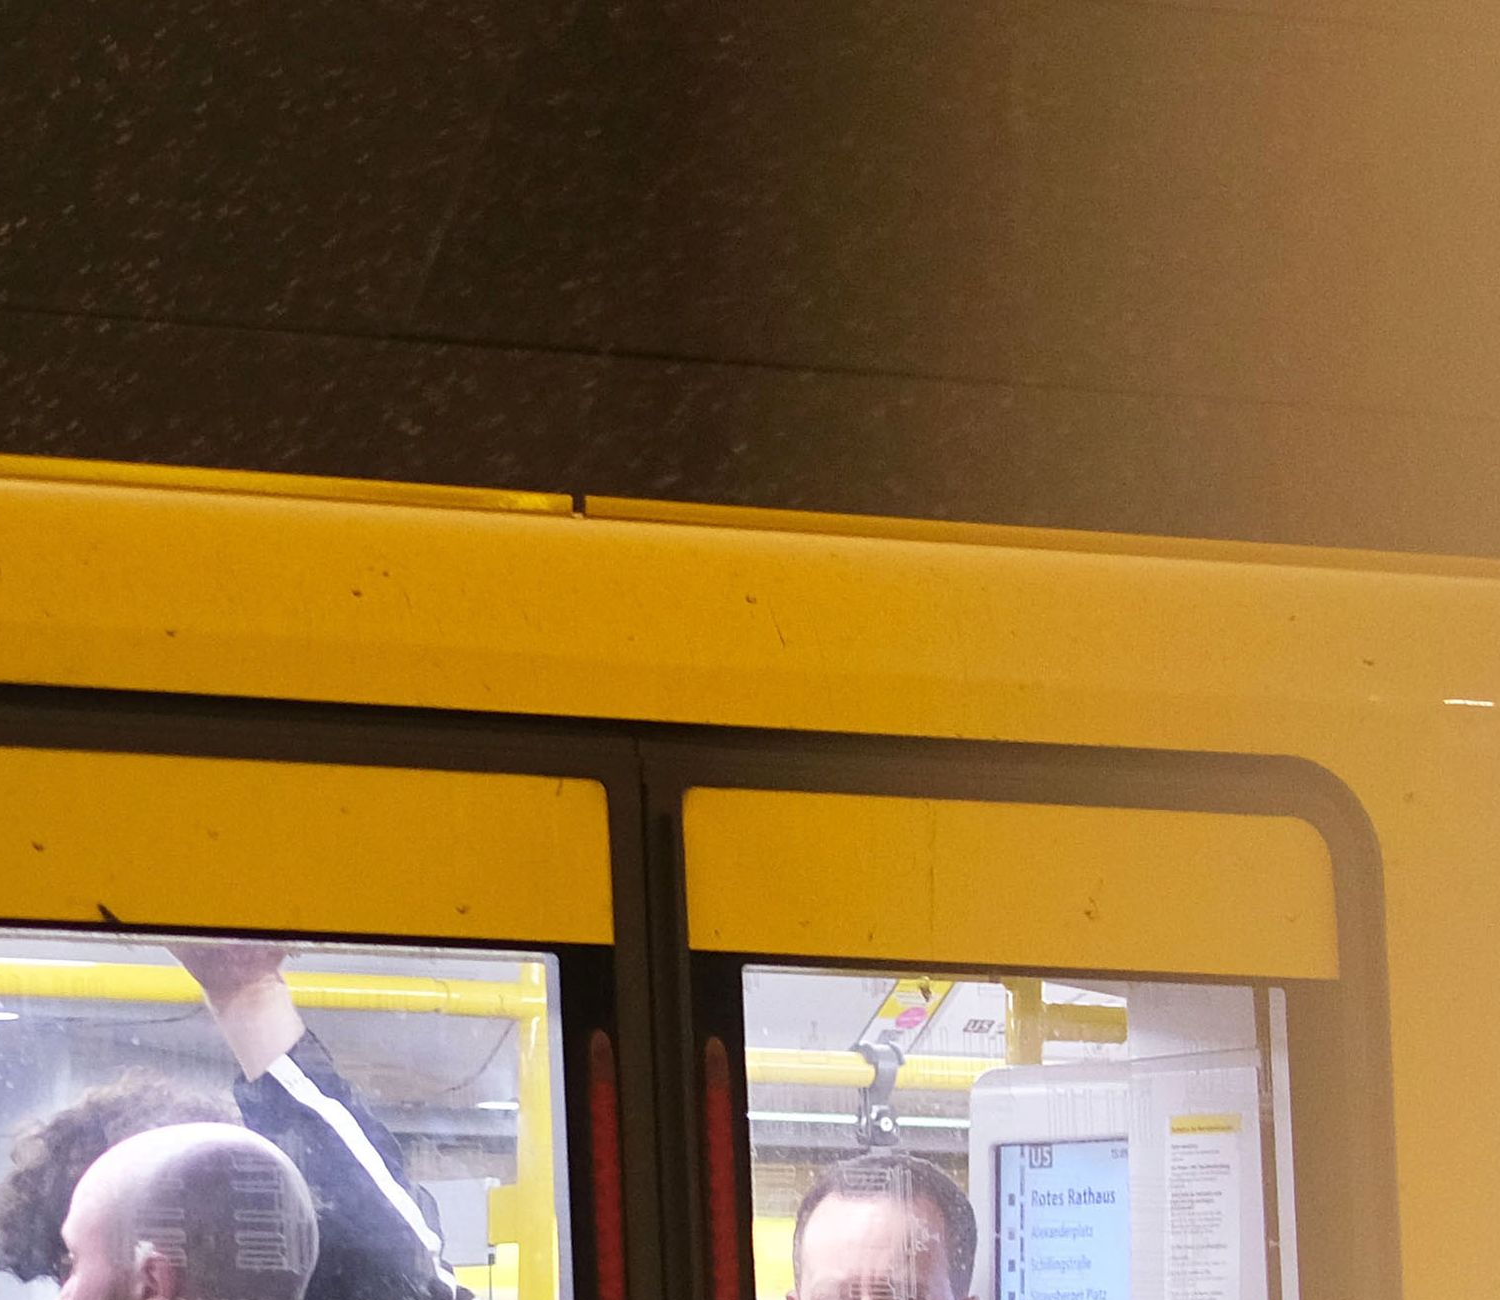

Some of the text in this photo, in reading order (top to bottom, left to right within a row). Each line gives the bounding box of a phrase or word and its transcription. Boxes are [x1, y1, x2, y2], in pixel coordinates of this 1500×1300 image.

[1030, 1146, 1051, 1166] U5
[1031, 1187, 1116, 1207] Rotes Rathaus
[1031, 1223, 1094, 1241] Alexanderplatz
